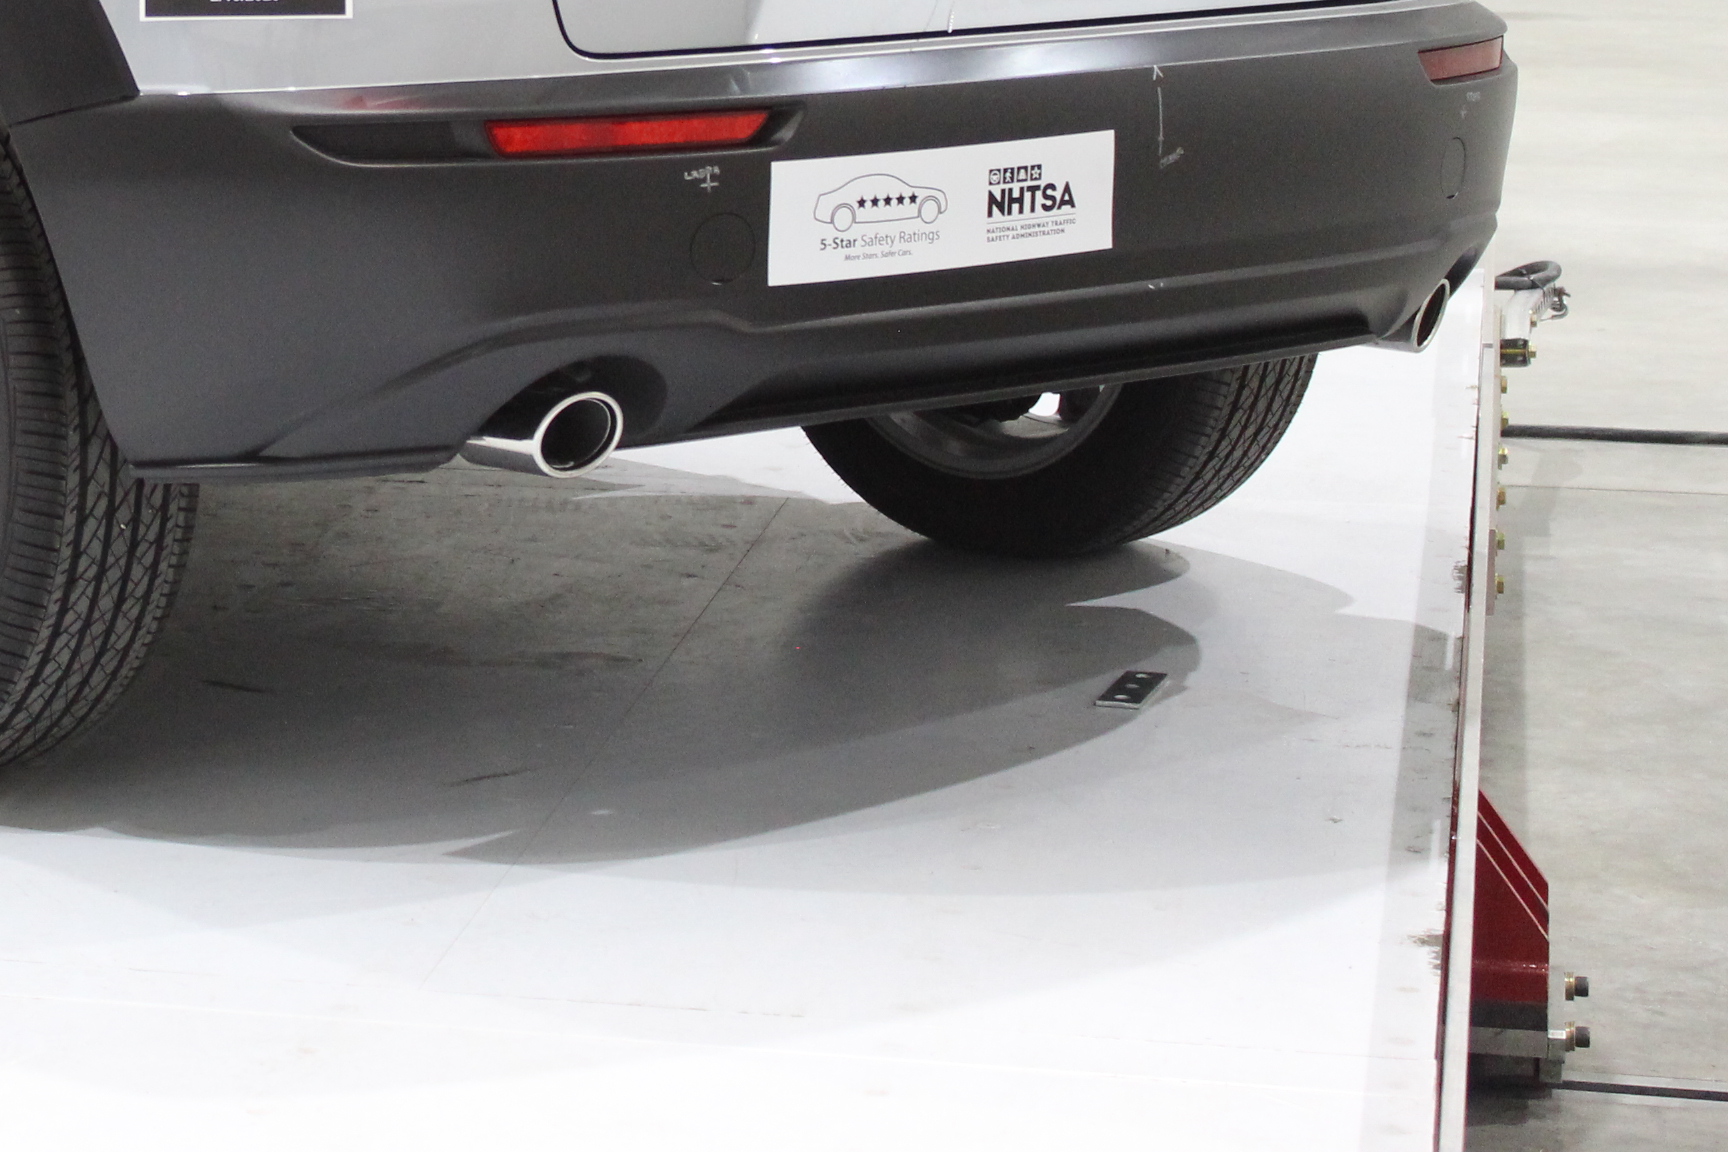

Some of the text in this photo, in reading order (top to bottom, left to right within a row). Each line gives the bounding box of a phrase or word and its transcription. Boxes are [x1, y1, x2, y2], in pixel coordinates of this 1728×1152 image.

[987, 180, 1076, 219] NHTSA
[986, 225, 1018, 235] NATIONAL
[1051, 217, 1077, 227] TRAFFIC
[819, 229, 941, 251] 5-Star Safety Ratings
[986, 228, 1065, 243] SAFETY ADMINISTRATION
[843, 252, 861, 261] More
[880, 249, 897, 258] Safer
